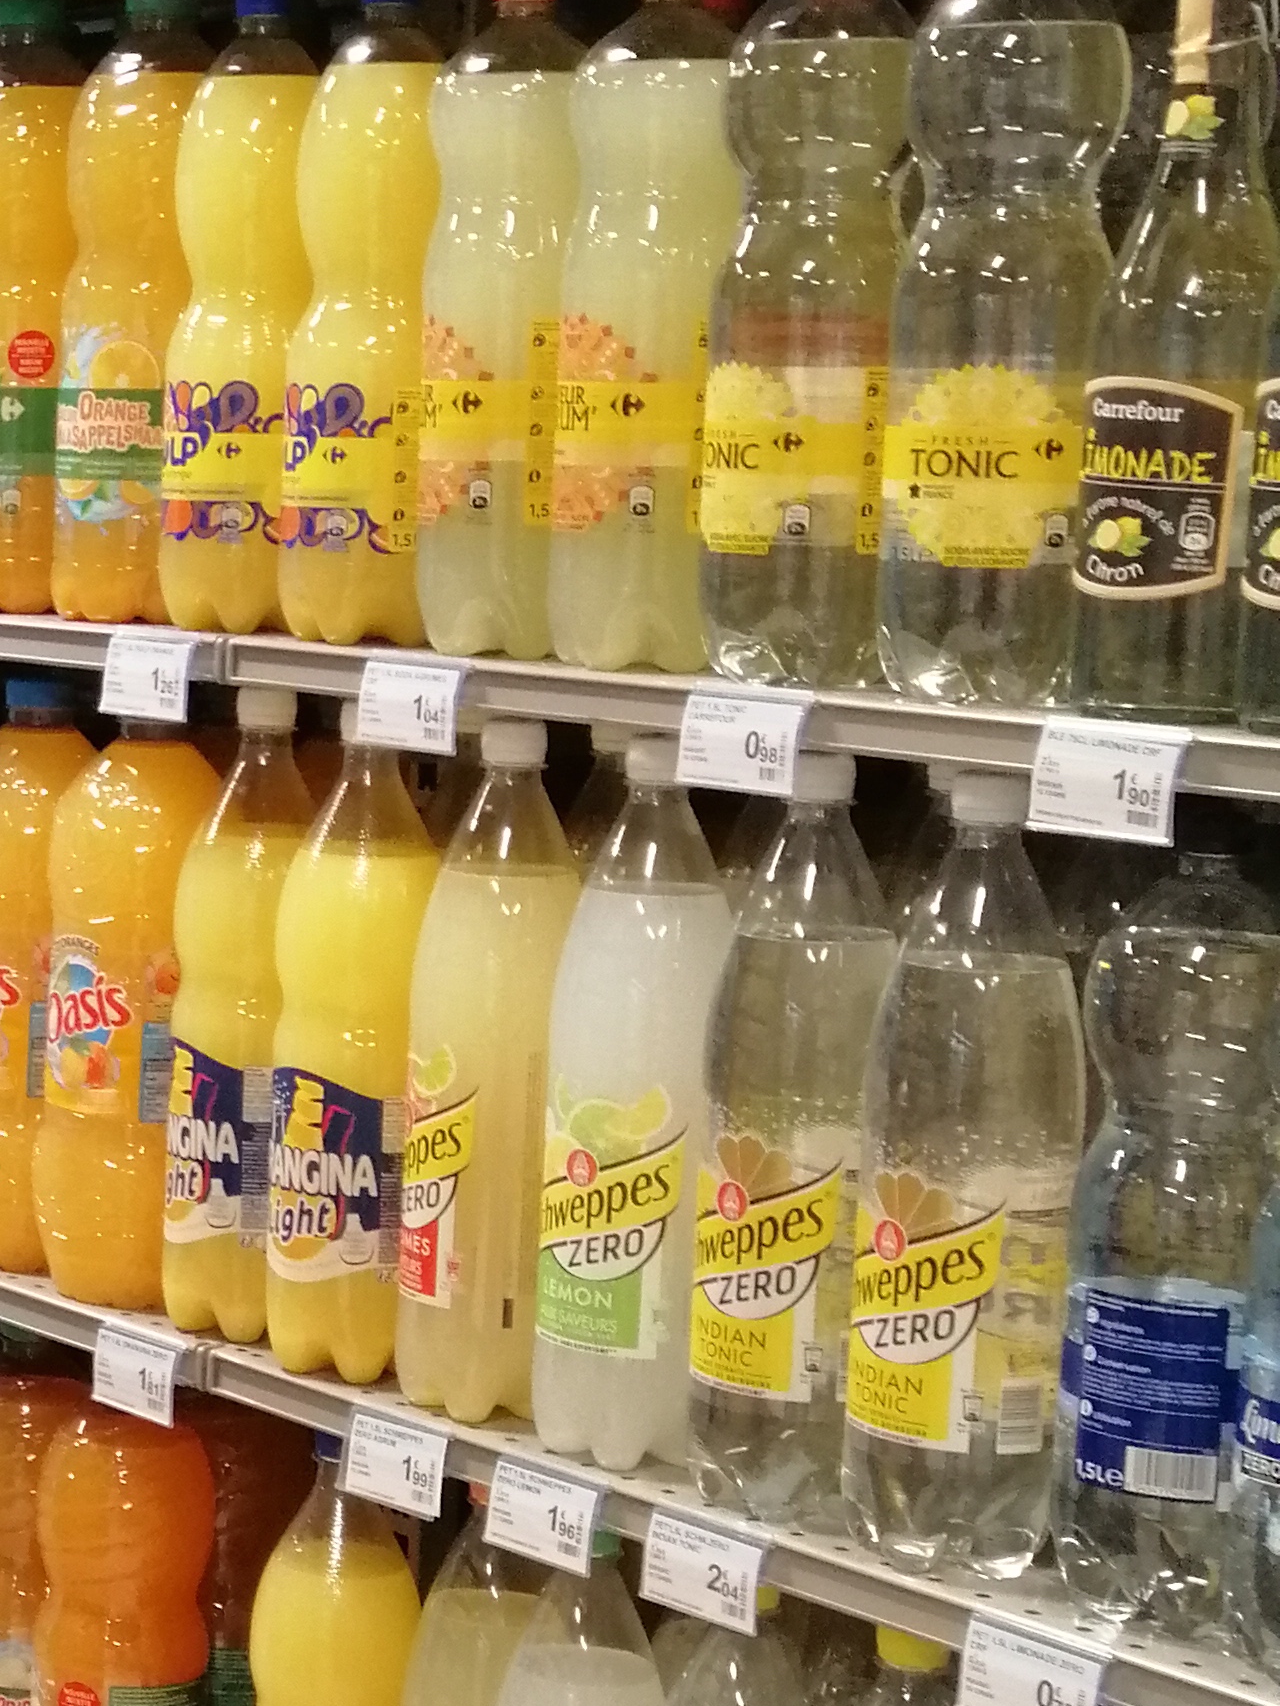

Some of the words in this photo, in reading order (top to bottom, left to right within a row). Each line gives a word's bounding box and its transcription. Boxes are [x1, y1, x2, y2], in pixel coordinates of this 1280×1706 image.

[79, 392, 148, 421] ORANGE
[1092, 398, 1184, 423] Carrefour
[912, 448, 1018, 478] TONIC
[568, 1227, 644, 1268] ZERO
[718, 1267, 796, 1307] ZERO
[873, 1310, 955, 1349] ZERO
[700, 1341, 753, 1368] TONIC
[856, 1389, 907, 1416] TONIC
